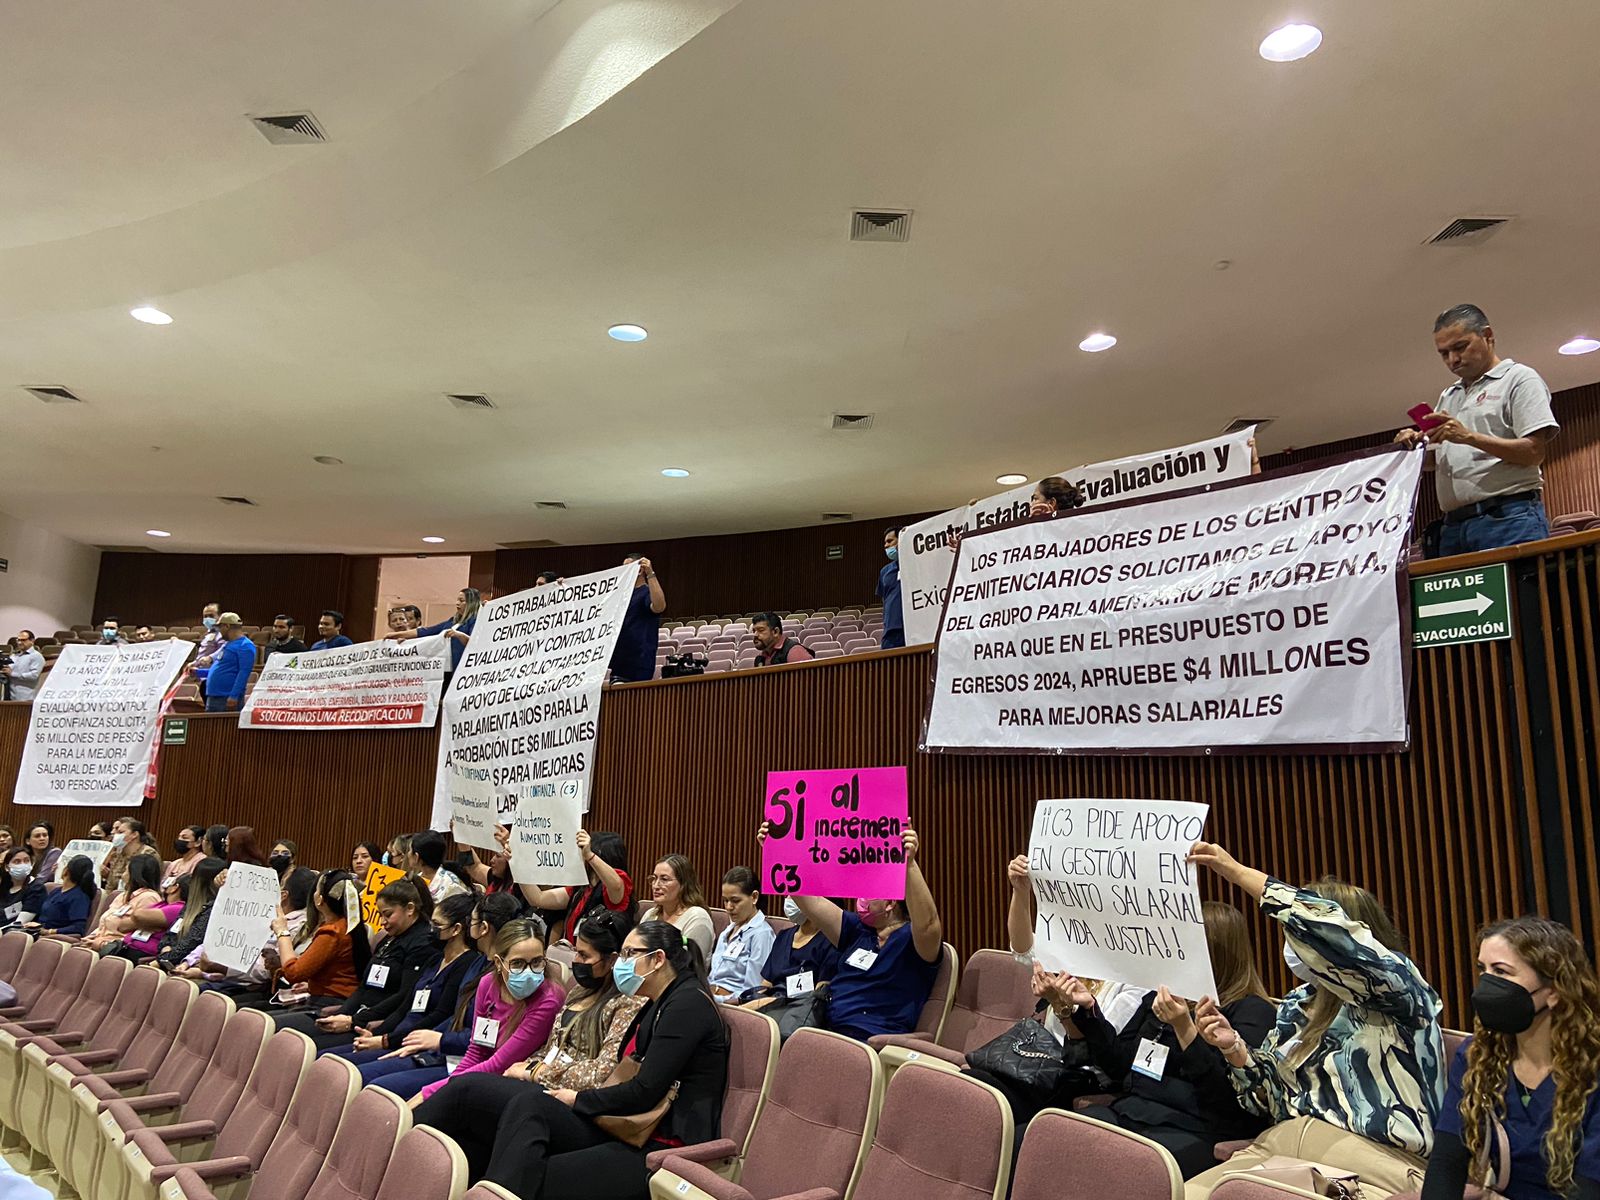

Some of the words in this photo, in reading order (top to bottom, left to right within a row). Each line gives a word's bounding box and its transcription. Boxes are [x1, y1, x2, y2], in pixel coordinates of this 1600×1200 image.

[976, 500, 1030, 531] Estata
[1076, 451, 1206, 501] Evaluación
[1213, 444, 1230, 473] y
[971, 552, 997, 572] LOS
[1002, 529, 1152, 565] TRABAJADORES
[1158, 523, 1187, 544] DE
[1193, 514, 1237, 538] LOS
[1245, 477, 1387, 527] CENTROS
[952, 564, 1114, 604] PENITENCIARIOS
[1118, 542, 1264, 582] SOLICITAMOS
[1269, 536, 1299, 557] EL
[1305, 514, 1402, 547] APOYO
[946, 616, 974, 632] DEL
[979, 606, 1032, 629] GRUPO
[1037, 585, 1203, 621] PARLAMENTARIO
[1210, 576, 1241, 598] DE
[1248, 551, 1388, 591] MORENA,
[1424, 578, 1461, 592] RUTA
[1465, 574, 1484, 586] DE
[488, 604, 509, 622] LOS
[512, 582, 597, 616] TRABAJADORES
[598, 576, 619, 596] DEL
[493, 620, 535, 642] CENTRO
[536, 608, 584, 632] ESTATAL
[587, 604, 603, 620] DE
[974, 640, 1017, 661] PARA
[1021, 637, 1054, 656] QUE
[1060, 634, 1085, 653] EN
[1090, 631, 1113, 650] EL
[1118, 608, 1285, 648] PRESUPUESTO
[1293, 602, 1329, 629] DE
[1413, 621, 1504, 642] EVACUACIÓN
[152, 648, 165, 659] DE
[464, 640, 534, 668] EVALUACIÓN
[534, 639, 545, 654] Y
[544, 627, 599, 652] CONTROL
[598, 620, 614, 639] DE
[78, 663, 103, 675] AÑOS
[124, 661, 165, 674] AUMENTO
[301, 656, 335, 670] SERVICIOS
[336, 654, 346, 665] DE
[346, 651, 369, 664] SALUD
[399, 660, 431, 672] FUNCIONES
[456, 666, 517, 691] CONFIANZA
[516, 649, 591, 679] SOLICITAMOS
[592, 645, 605, 661] EL
[951, 674, 1029, 694] EGRESOS
[1034, 672, 1077, 692] 2024,
[1081, 662, 1177, 688] APRUEBE
[1183, 656, 1212, 684] $4
[1220, 637, 1371, 679] MILLONES
[44, 690, 54, 700] EL
[460, 687, 498, 712] APOYO
[499, 687, 515, 703] DE
[514, 682, 536, 699] LOS
[536, 672, 586, 694] GRUPOS
[98, 702, 106, 712] Y
[106, 702, 148, 712] CONTROL
[260, 709, 316, 722] SOLICITAMOS
[317, 709, 337, 722] UNA
[338, 706, 413, 722] RECODIFICACIÓN
[452, 704, 542, 740] PARLAMENTARIOS
[544, 698, 573, 722] PARA
[574, 694, 588, 714] LA
[999, 708, 1044, 726] PARA
[1049, 703, 1142, 725] MEJORAS
[1147, 694, 1283, 723] SALARIALES
[36, 718, 49, 728] DE
[52, 718, 104, 728] CONFIANZA
[106, 716, 146, 728] SOLICITA
[35, 732, 45, 744] $6
[47, 732, 94, 744] MILLONES
[97, 732, 110, 743] DE
[112, 732, 145, 743] PESOS
[445, 736, 509, 768] APROBACIÓN
[512, 737, 525, 756] DE
[527, 734, 540, 756] $6
[541, 720, 595, 750] MILLONES
[47, 748, 74, 759] PARA
[76, 748, 86, 758] LA
[87, 748, 128, 760] MEJORA
[36, 763, 80, 774] SALARIAL
[82, 764, 96, 774] DE
[120, 763, 135, 774] DE
[501, 764, 530, 785] PARA
[533, 752, 586, 780] MEJORAS
[50, 780, 65, 790] 130
[68, 780, 119, 790] PERSONAS.
[560, 780, 579, 799] (C3)
[768, 780, 806, 841] Si
[832, 773, 859, 811] al
[514, 811, 552, 829] Solicitamos
[1087, 808, 1124, 839] PIDE
[1131, 812, 1203, 841] APOYO
[520, 832, 550, 846] AUMENTO
[554, 833, 564, 844] DE
[536, 850, 564, 868] SUELDO
[809, 839, 830, 863] to
[838, 841, 906, 864] salarial
[1031, 846, 1052, 871] EN
[1062, 846, 1137, 880] GESTIÓN
[1159, 853, 1190, 886] EN
[771, 863, 802, 893] C3
[222, 898, 260, 918] AUMENTO
[261, 904, 274, 918] DE
[1035, 878, 1103, 912] AUMENTO
[1111, 884, 1205, 924] SALARIAL
[215, 927, 246, 949] SUELDO
[1040, 914, 1054, 941] Y
[1060, 917, 1099, 948] VIDA
[1104, 923, 1186, 960] JUSTA!!
[374, 970, 380, 982] 4
[796, 978, 803, 991] 4
[482, 1024, 490, 1040] 4
[1144, 1049, 1154, 1068] 4
